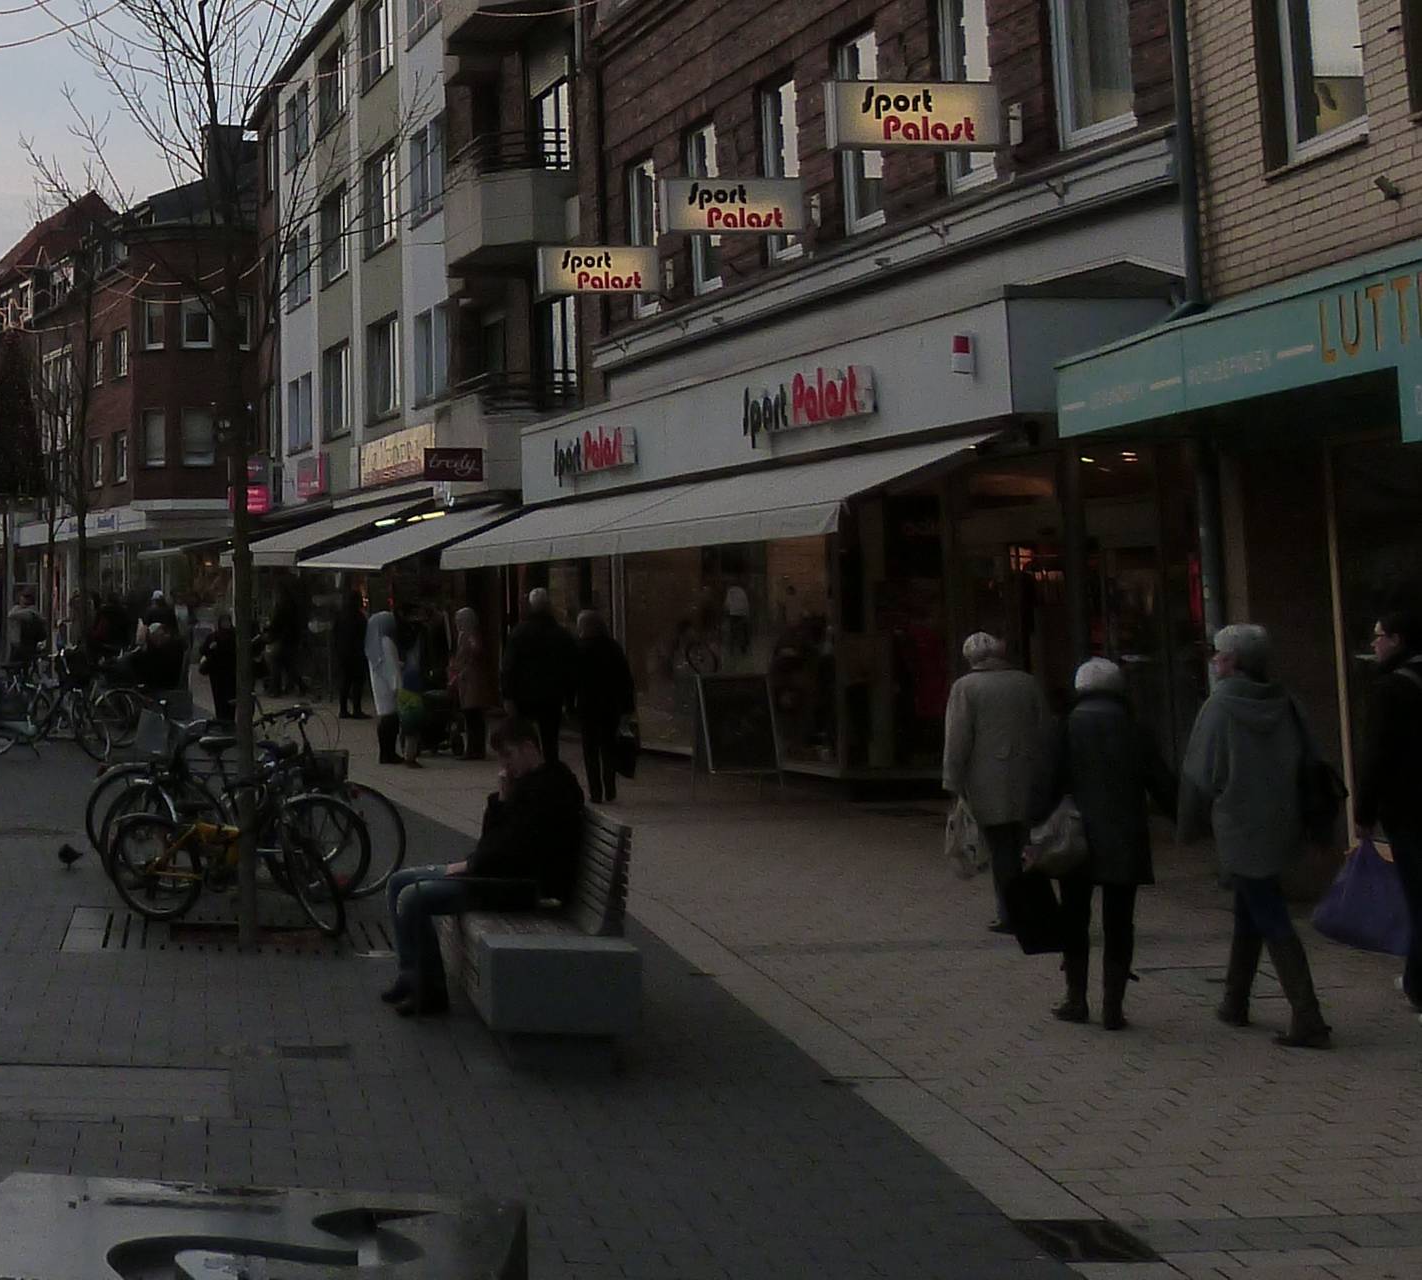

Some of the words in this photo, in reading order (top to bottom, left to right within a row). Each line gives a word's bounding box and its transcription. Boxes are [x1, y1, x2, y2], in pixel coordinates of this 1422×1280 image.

[862, 86, 932, 119] Sport
[883, 115, 975, 141] Palast
[689, 182, 746, 209] Sport
[707, 207, 783, 228] Palast
[562, 250, 612, 273] Sport
[578, 271, 642, 289] Palast
[1319, 271, 1422, 363] LUTT
[743, 383, 788, 449] Sport
[792, 365, 858, 425] Palast
[553, 437, 582, 488] Sport
[583, 426, 623, 471] Palast
